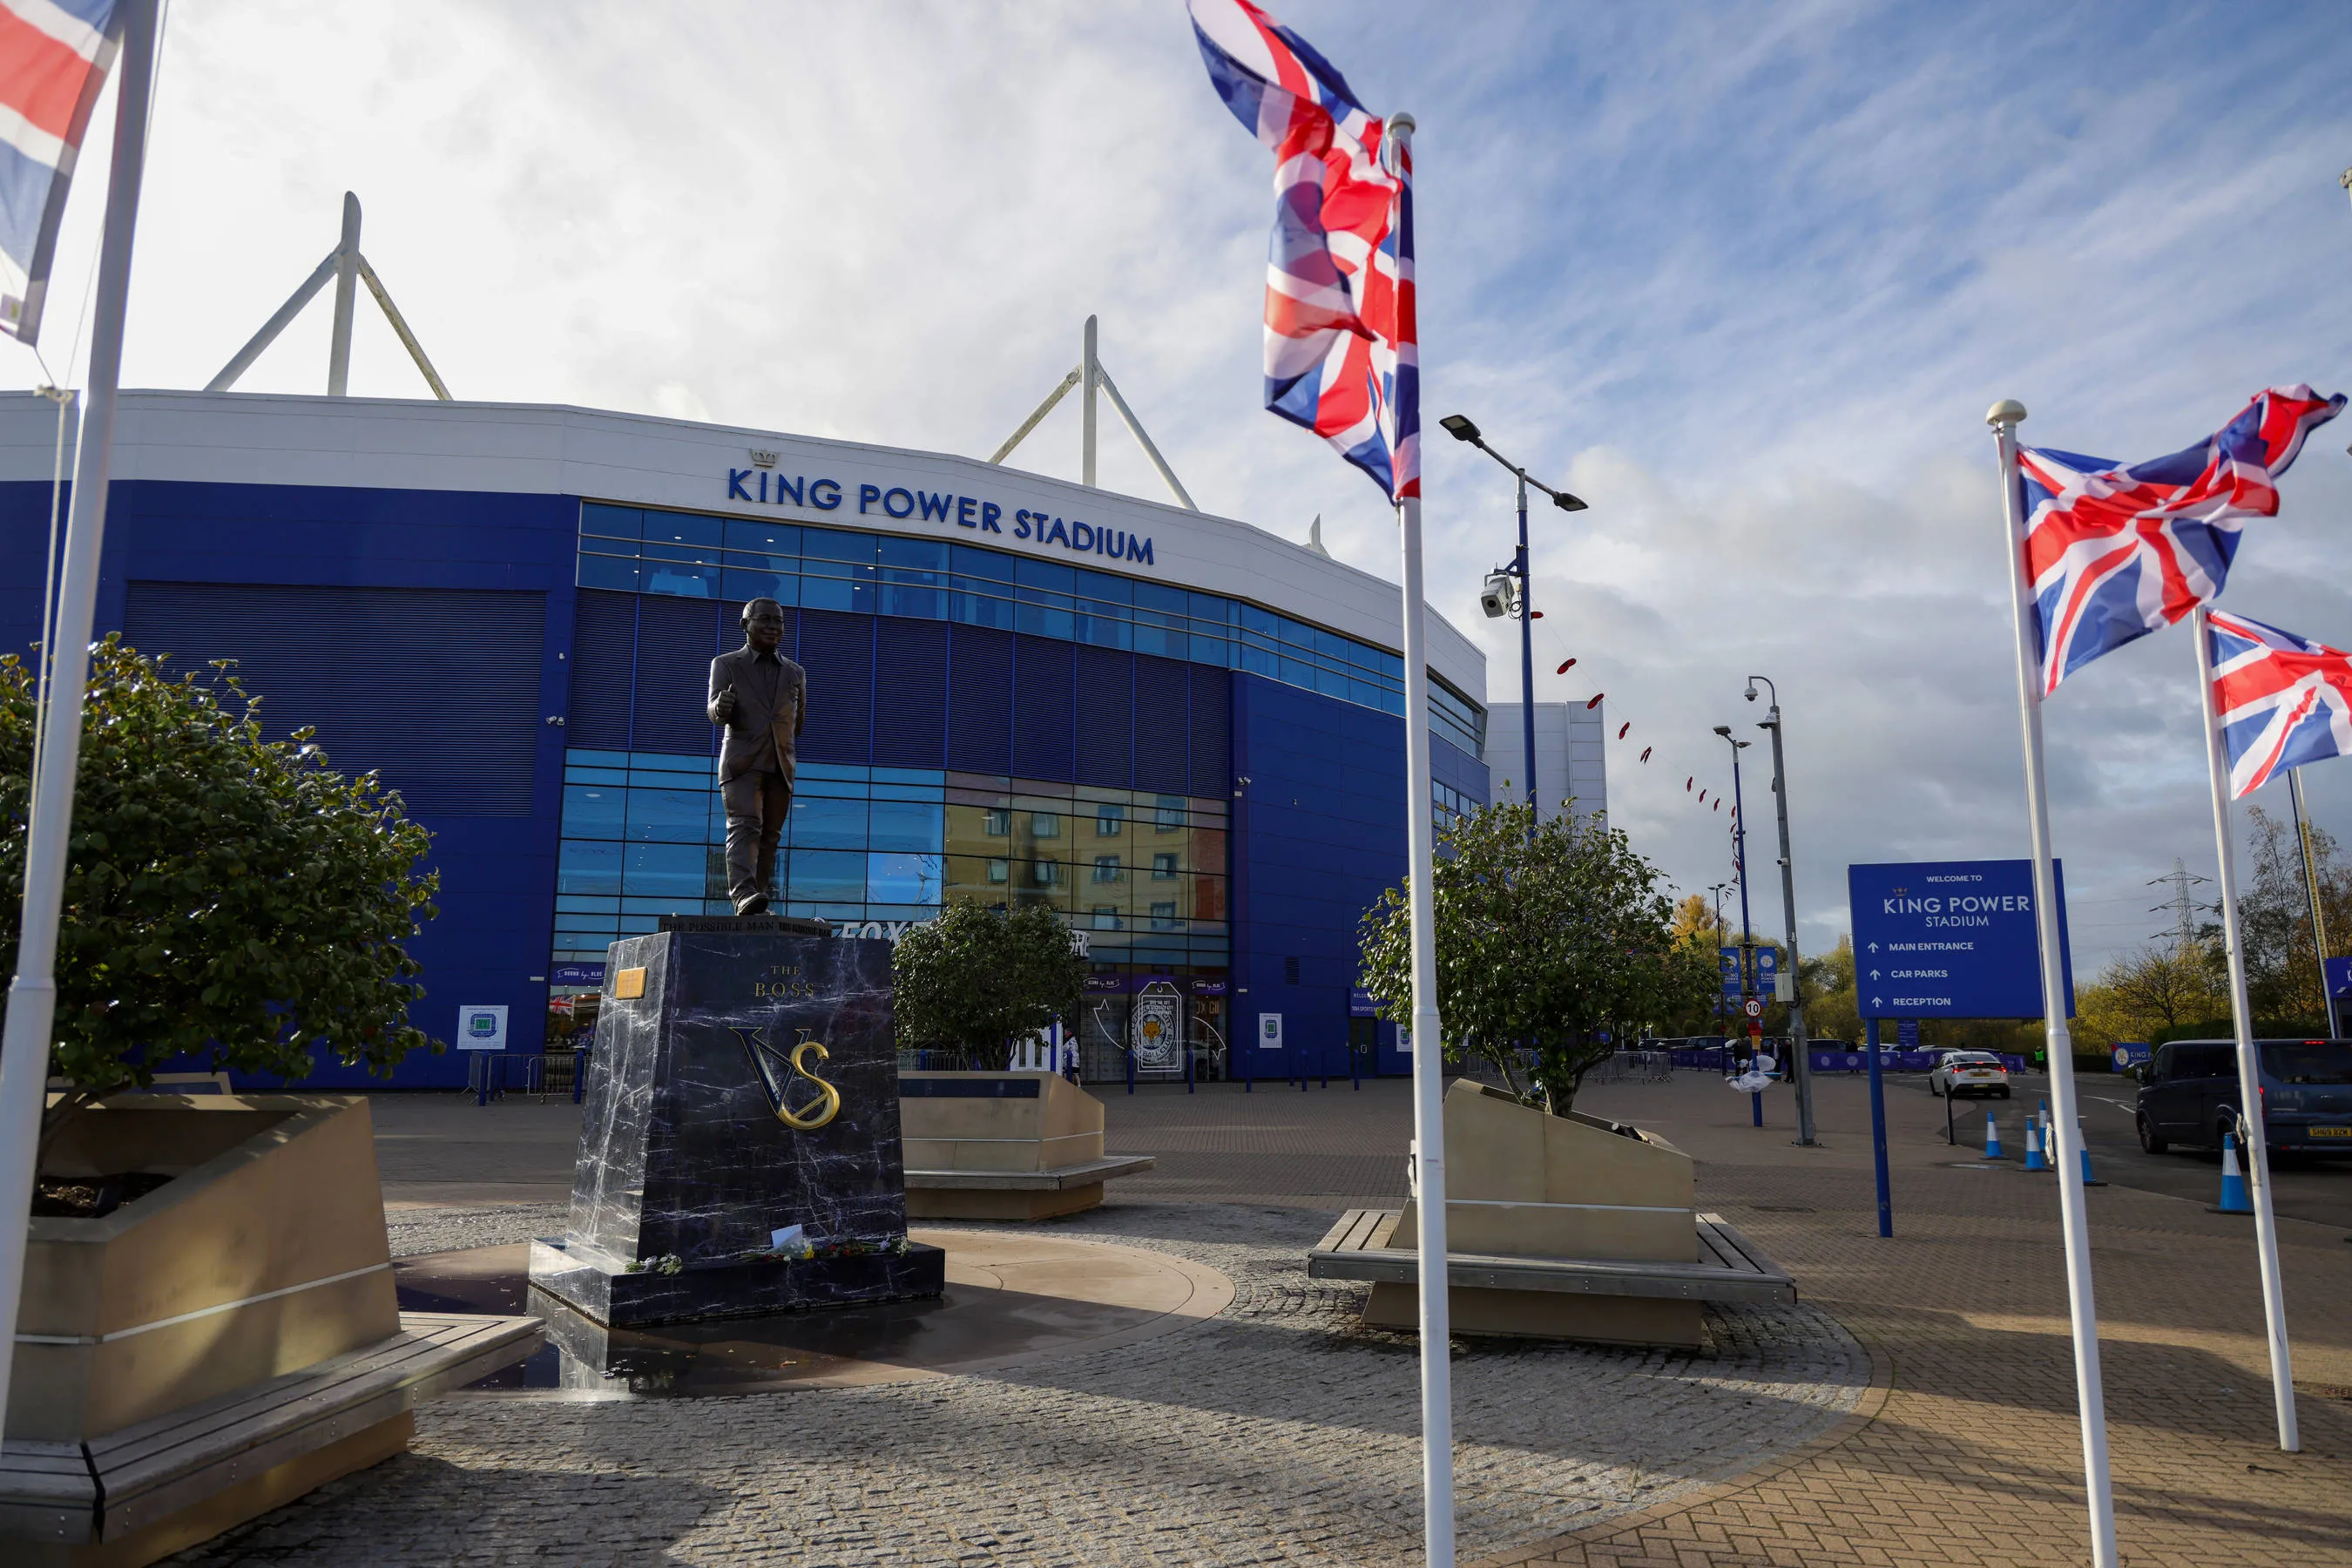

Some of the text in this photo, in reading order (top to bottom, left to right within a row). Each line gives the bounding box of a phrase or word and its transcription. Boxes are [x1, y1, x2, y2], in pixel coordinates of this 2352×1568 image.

[728, 468, 1155, 566] KING POWER STADIUM
[1883, 896, 2031, 914] KING POWER
[662, 922, 774, 932] THE POSSIBLE MAN
[1925, 916, 1990, 928] STADIUM
[1889, 942, 1974, 951] MAIN ENTRANCE
[1914, 970, 1949, 978] PARKS
[754, 965, 814, 997] THE BOSS
[1893, 997, 1951, 1006] RECEPTION
[1747, 1004, 1759, 1013] 10
